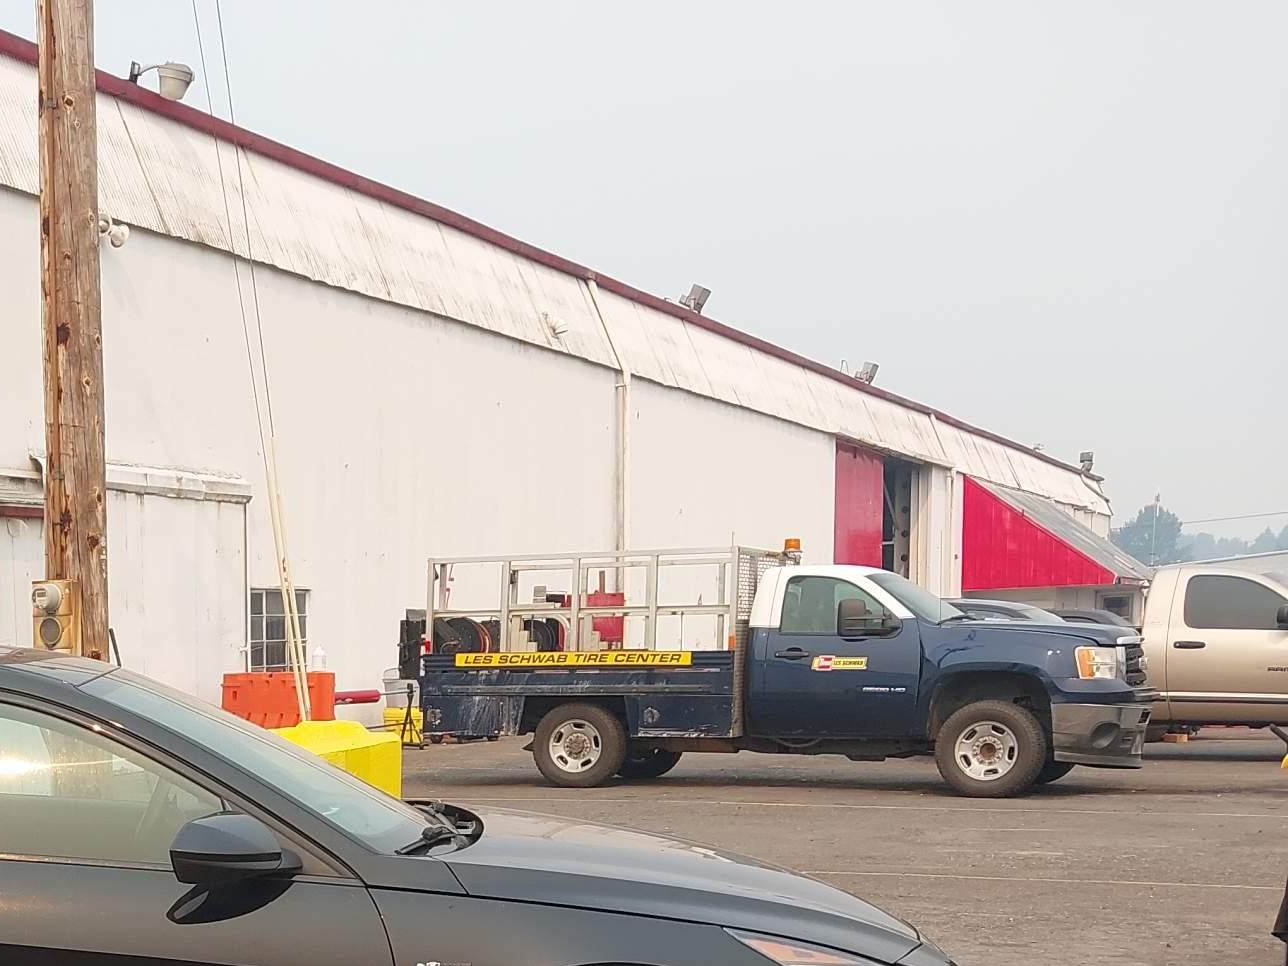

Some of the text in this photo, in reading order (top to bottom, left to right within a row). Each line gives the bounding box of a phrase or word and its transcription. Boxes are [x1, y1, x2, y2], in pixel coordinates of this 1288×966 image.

[464, 653, 681, 664] LES SCHWAB TIRE CENTER
